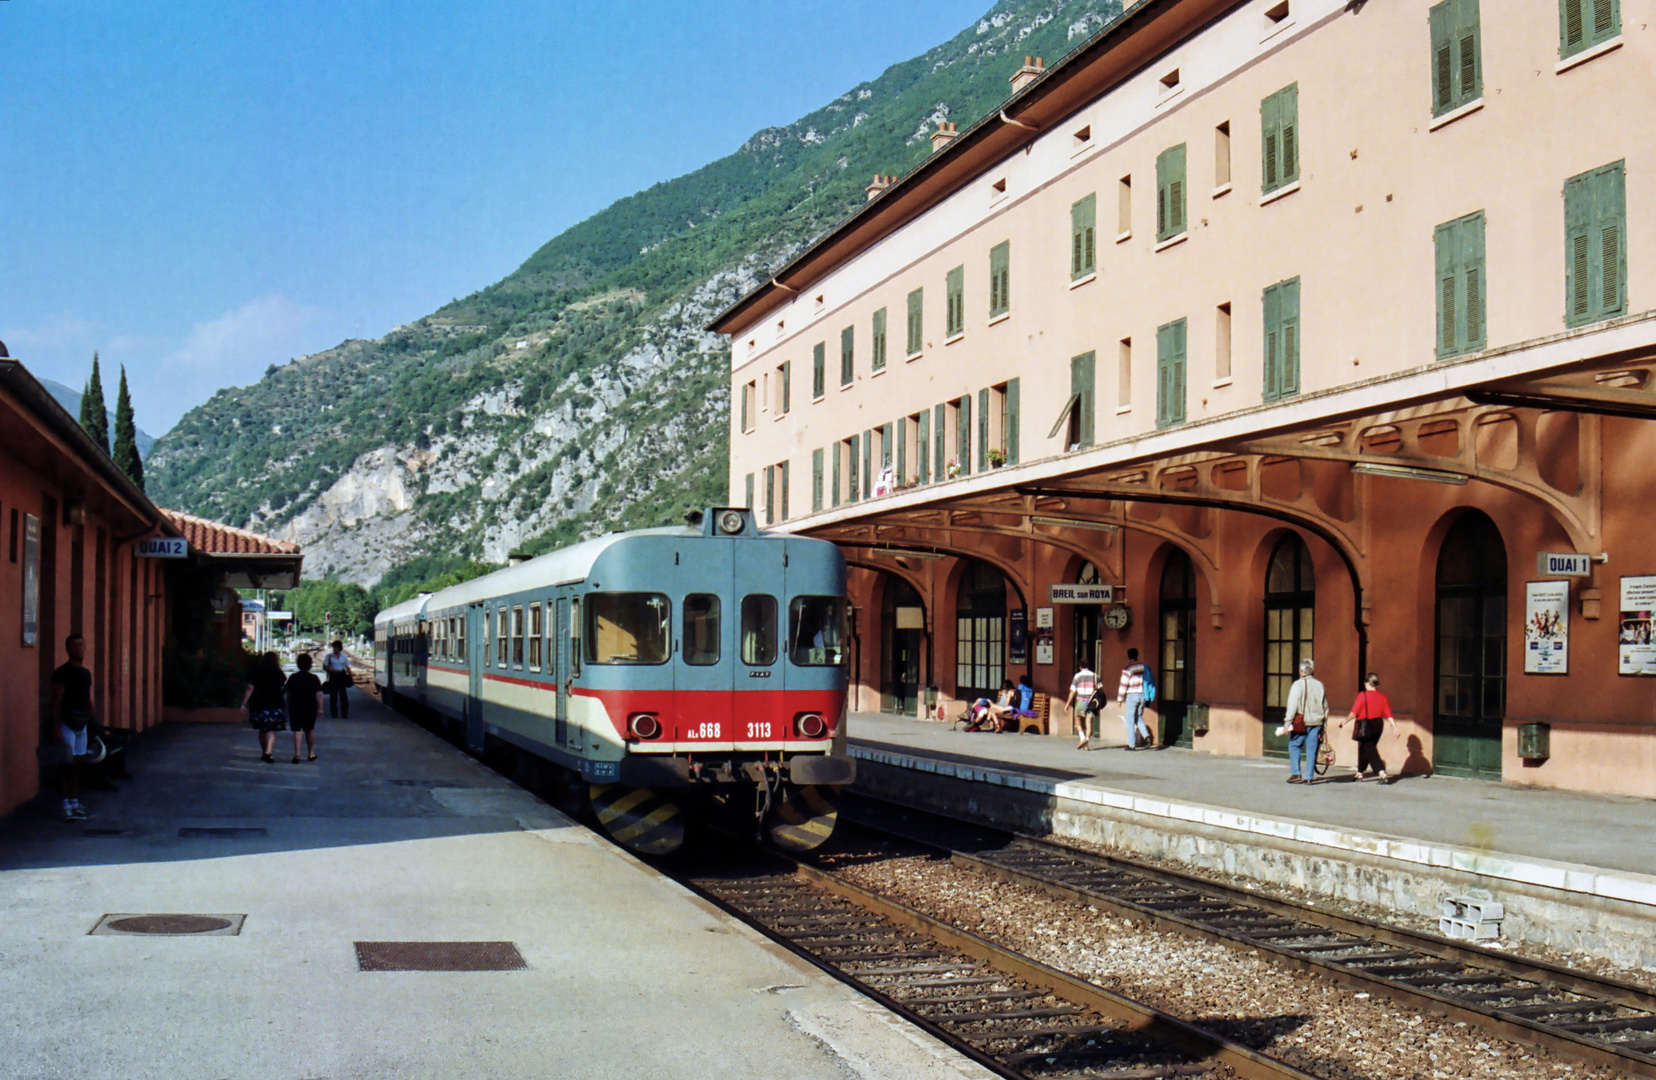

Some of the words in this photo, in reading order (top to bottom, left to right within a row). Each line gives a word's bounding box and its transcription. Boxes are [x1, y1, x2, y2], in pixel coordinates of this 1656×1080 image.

[140, 541, 172, 554] QUAI
[173, 542, 183, 555] 2
[1550, 557, 1577, 572] QUAI
[1582, 558, 1587, 572] 1
[1053, 589, 1075, 599] BREIL
[1089, 589, 1110, 599] ROYA
[747, 722, 771, 739] 3113
